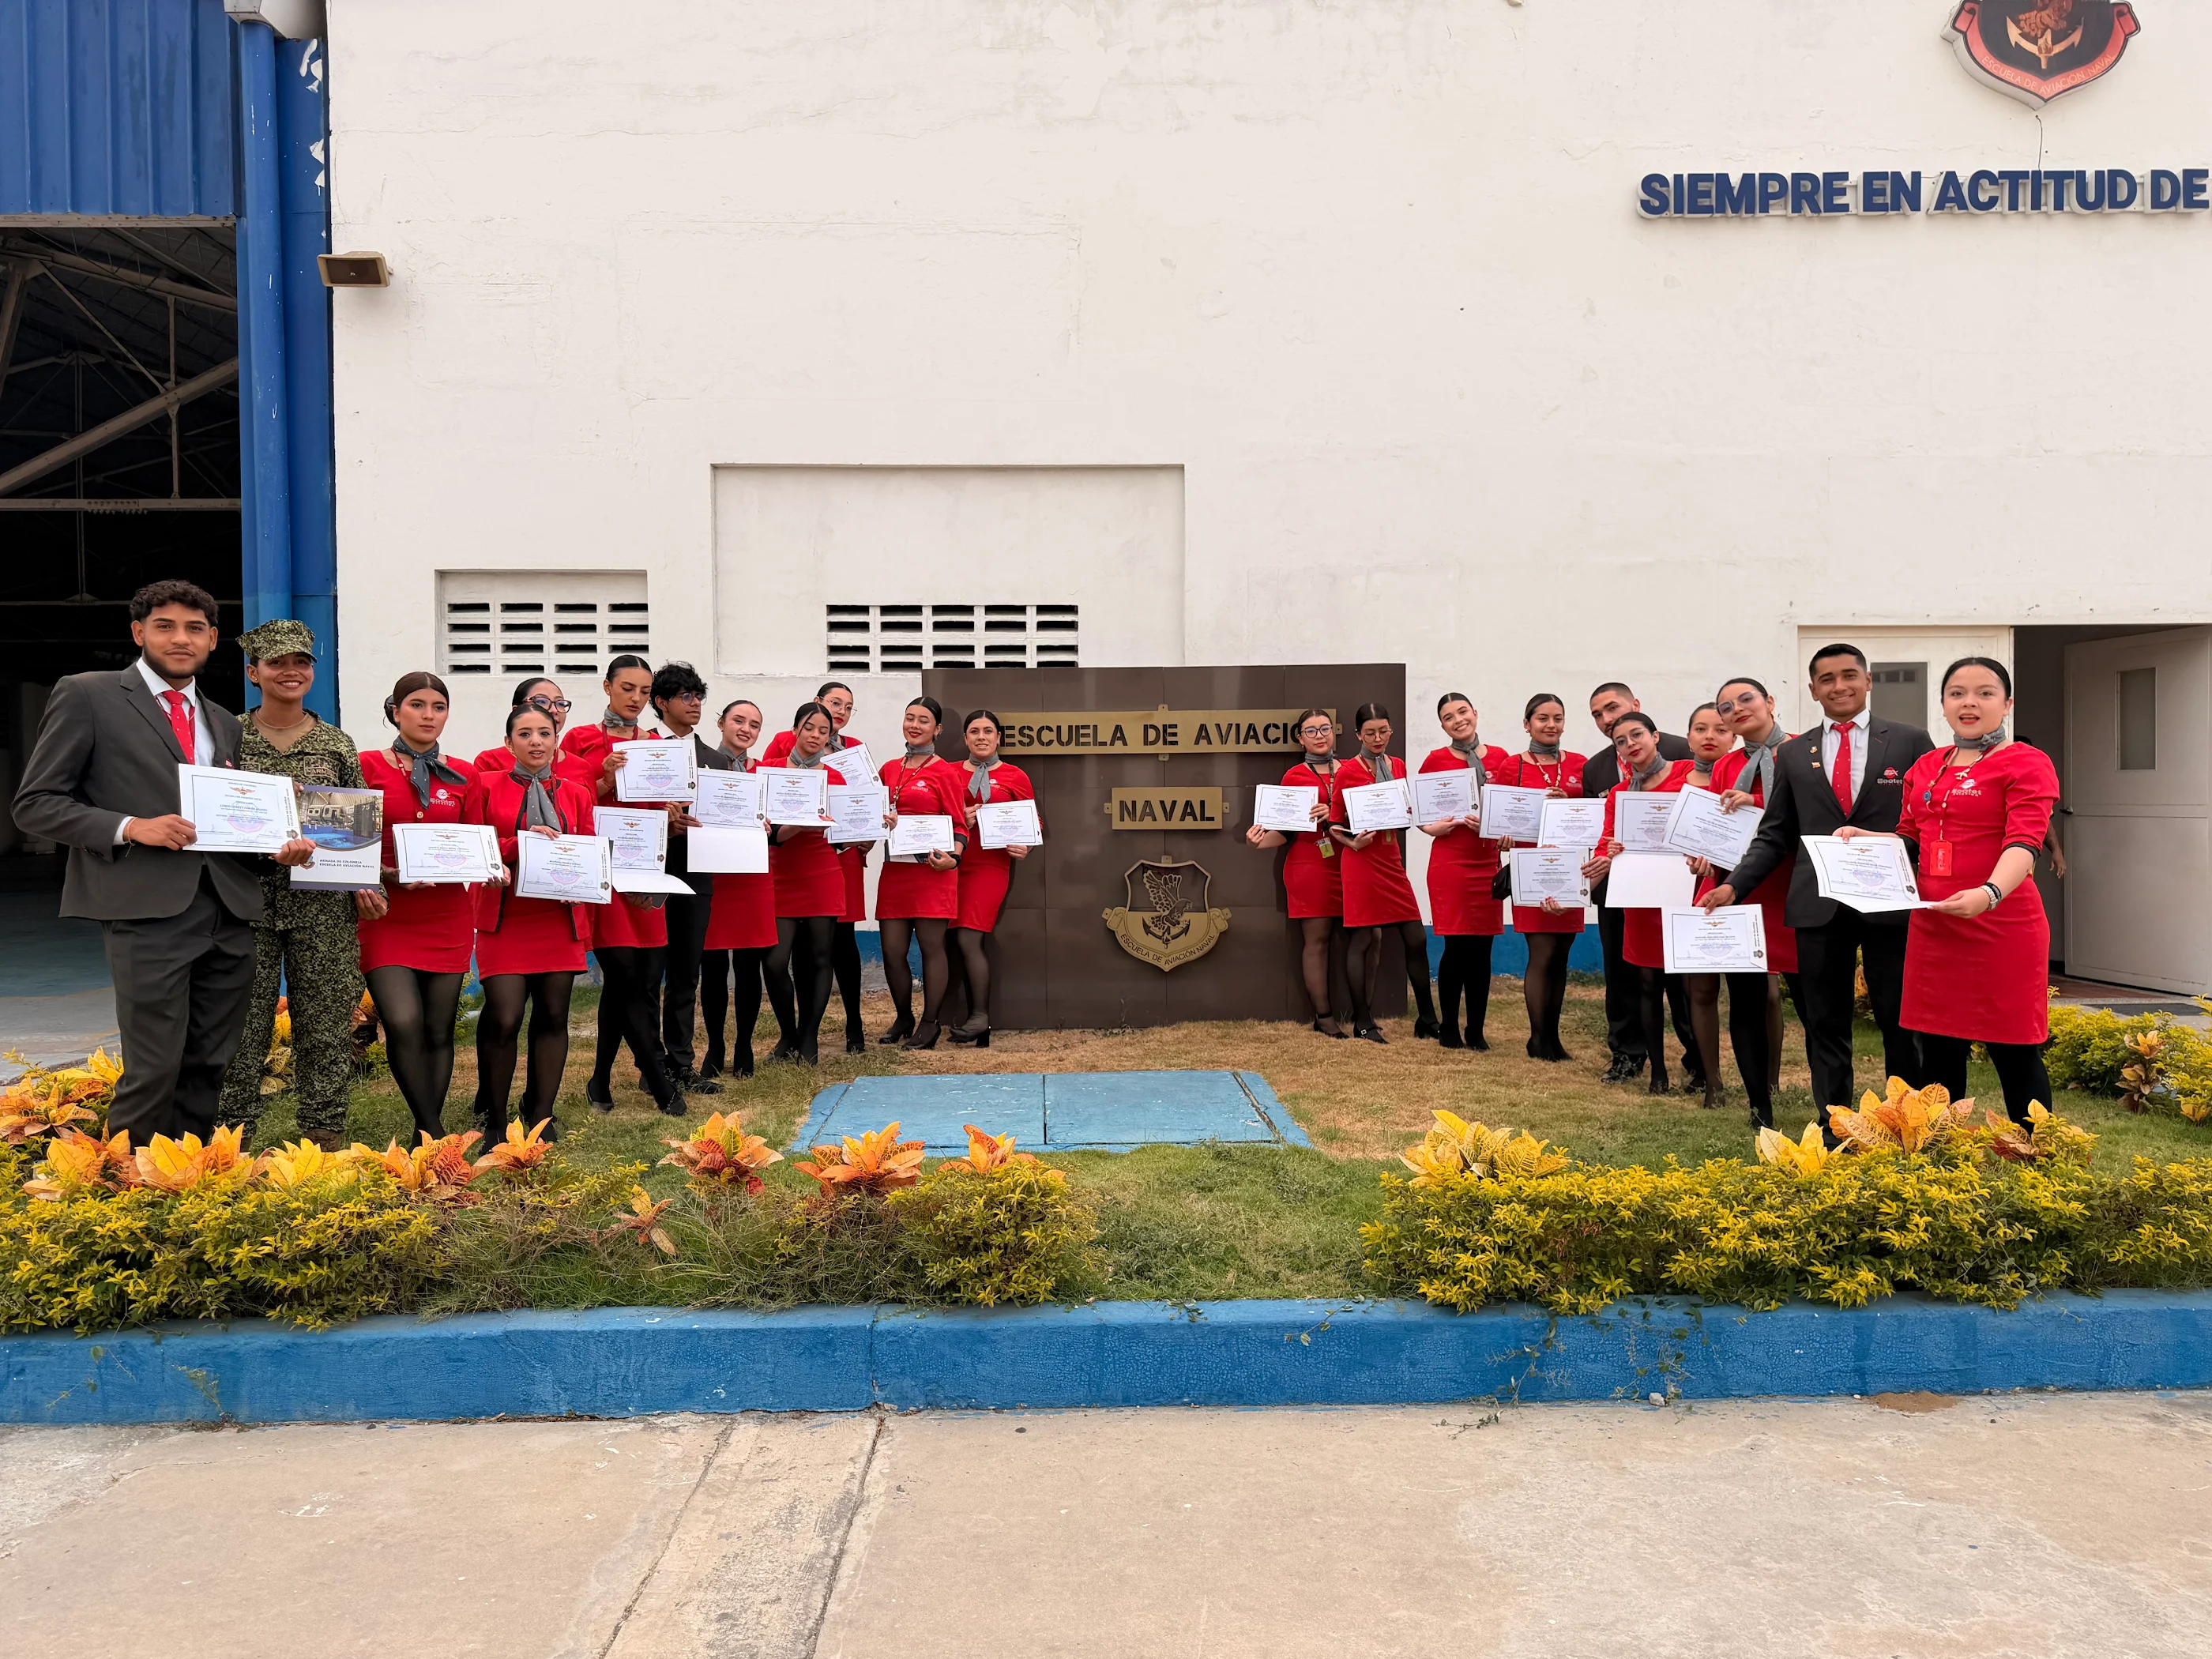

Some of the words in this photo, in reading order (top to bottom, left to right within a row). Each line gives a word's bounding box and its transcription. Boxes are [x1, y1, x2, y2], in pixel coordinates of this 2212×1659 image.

[1981, 55, 2021, 85] ESCUELA
[2024, 79, 2037, 90] DE
[2087, 54, 2115, 77] NAVAL
[1638, 171, 1849, 214] SIEMPRE
[1863, 171, 1922, 212] EN
[1933, 169, 2137, 213] ACTITUD
[2150, 168, 2210, 210] DE
[999, 724, 1128, 747] ESCUELA
[1143, 724, 1179, 746] DE
[1194, 722, 1300, 746] AVIACI
[1119, 799, 1215, 822] NAVAL
[1120, 933, 1150, 958] ESCUELA
[1152, 954, 1163, 963] DE
[1164, 949, 1197, 966] AVIACIÓN
[1196, 934, 1216, 954] NAVAL
